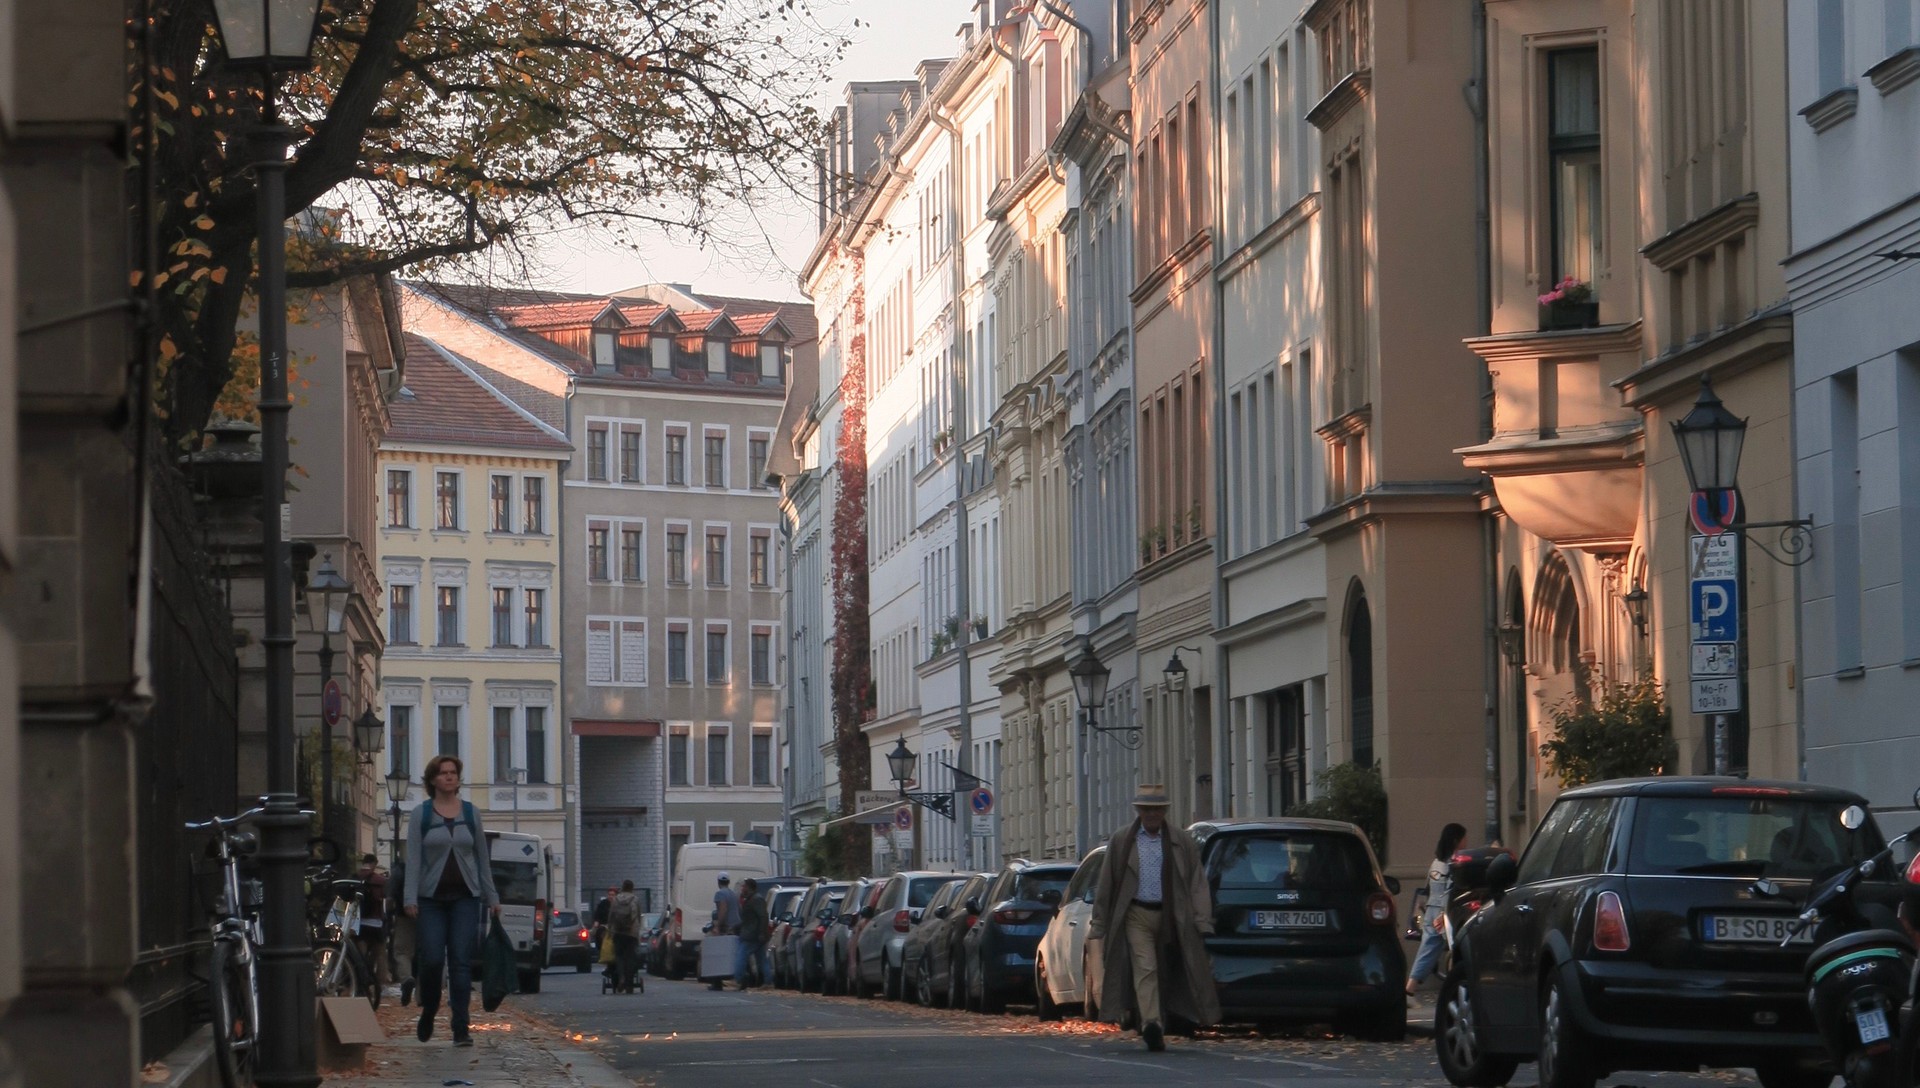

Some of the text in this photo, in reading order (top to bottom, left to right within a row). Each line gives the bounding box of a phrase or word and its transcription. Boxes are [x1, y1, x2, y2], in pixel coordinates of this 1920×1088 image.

[1701, 585, 1728, 637] P
[1700, 683, 1728, 695] Mo-Fr
[1257, 912, 1324, 925] B NR 7600
[1716, 918, 1728, 938] B
[1743, 919, 1768, 939] SQ
